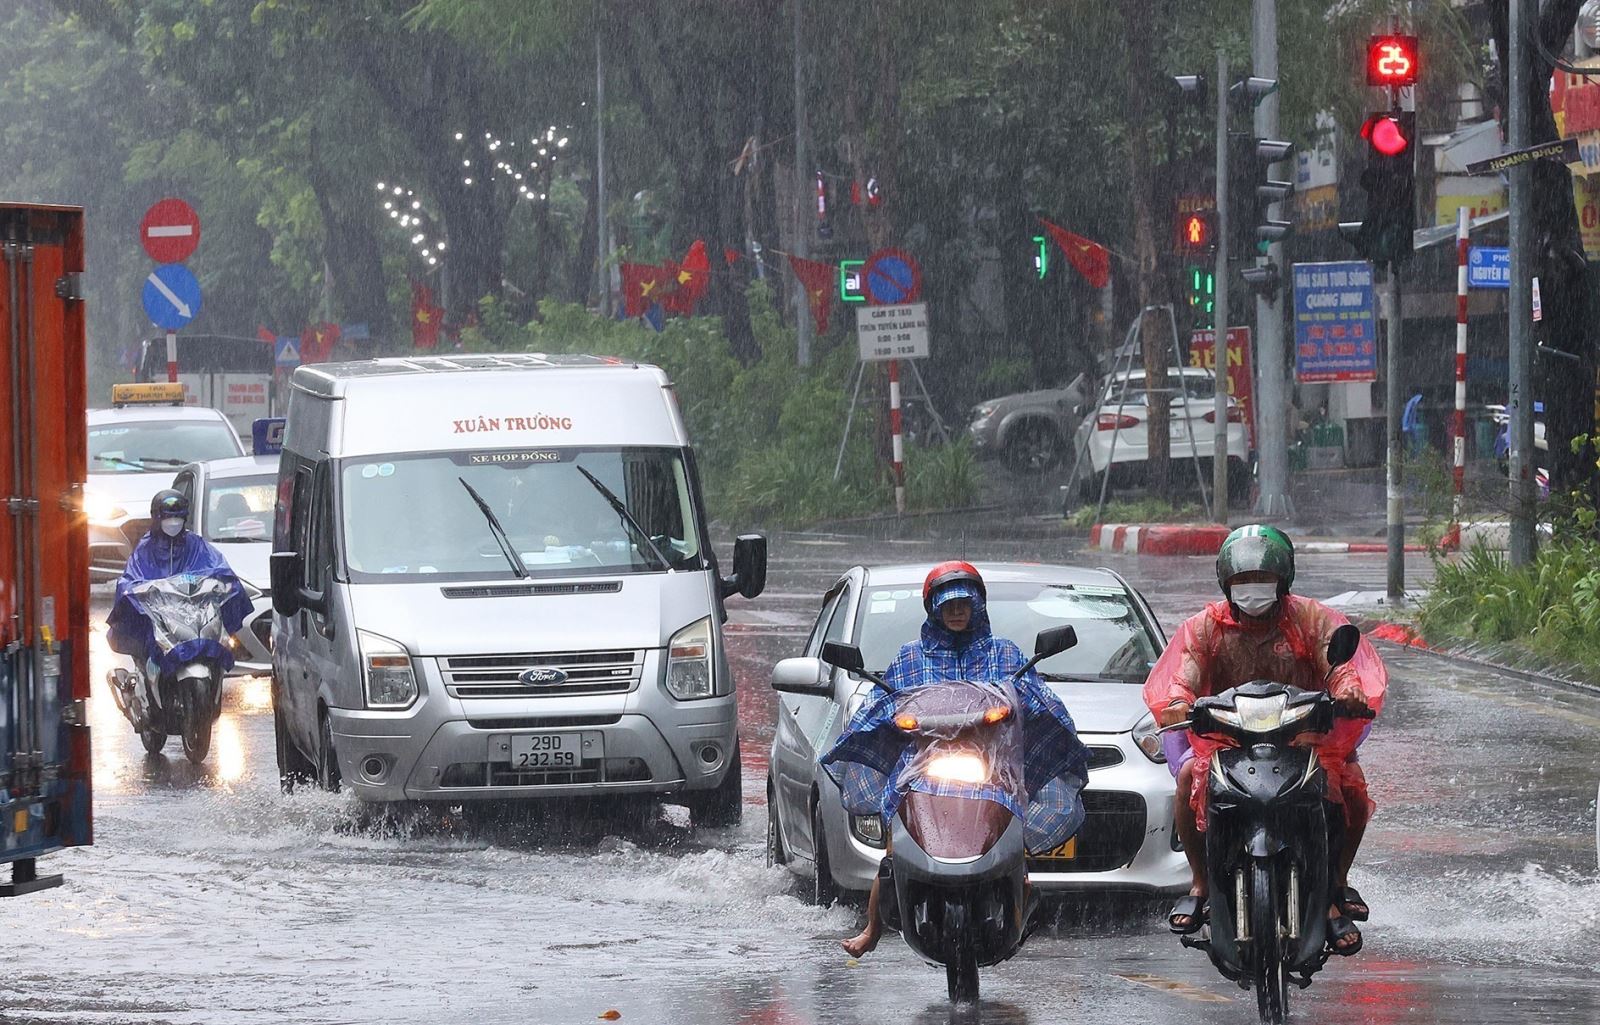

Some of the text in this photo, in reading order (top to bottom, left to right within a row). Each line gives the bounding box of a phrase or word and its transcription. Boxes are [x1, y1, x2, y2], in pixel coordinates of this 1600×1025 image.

[453, 412, 572, 433] XUÂN TRƯỜNG
[491, 454, 518, 462] HỢP
[521, 451, 557, 460] ĐỒNG
[529, 670, 556, 681] Ford
[531, 736, 561, 750] 29D
[519, 752, 574, 767] 232.59
